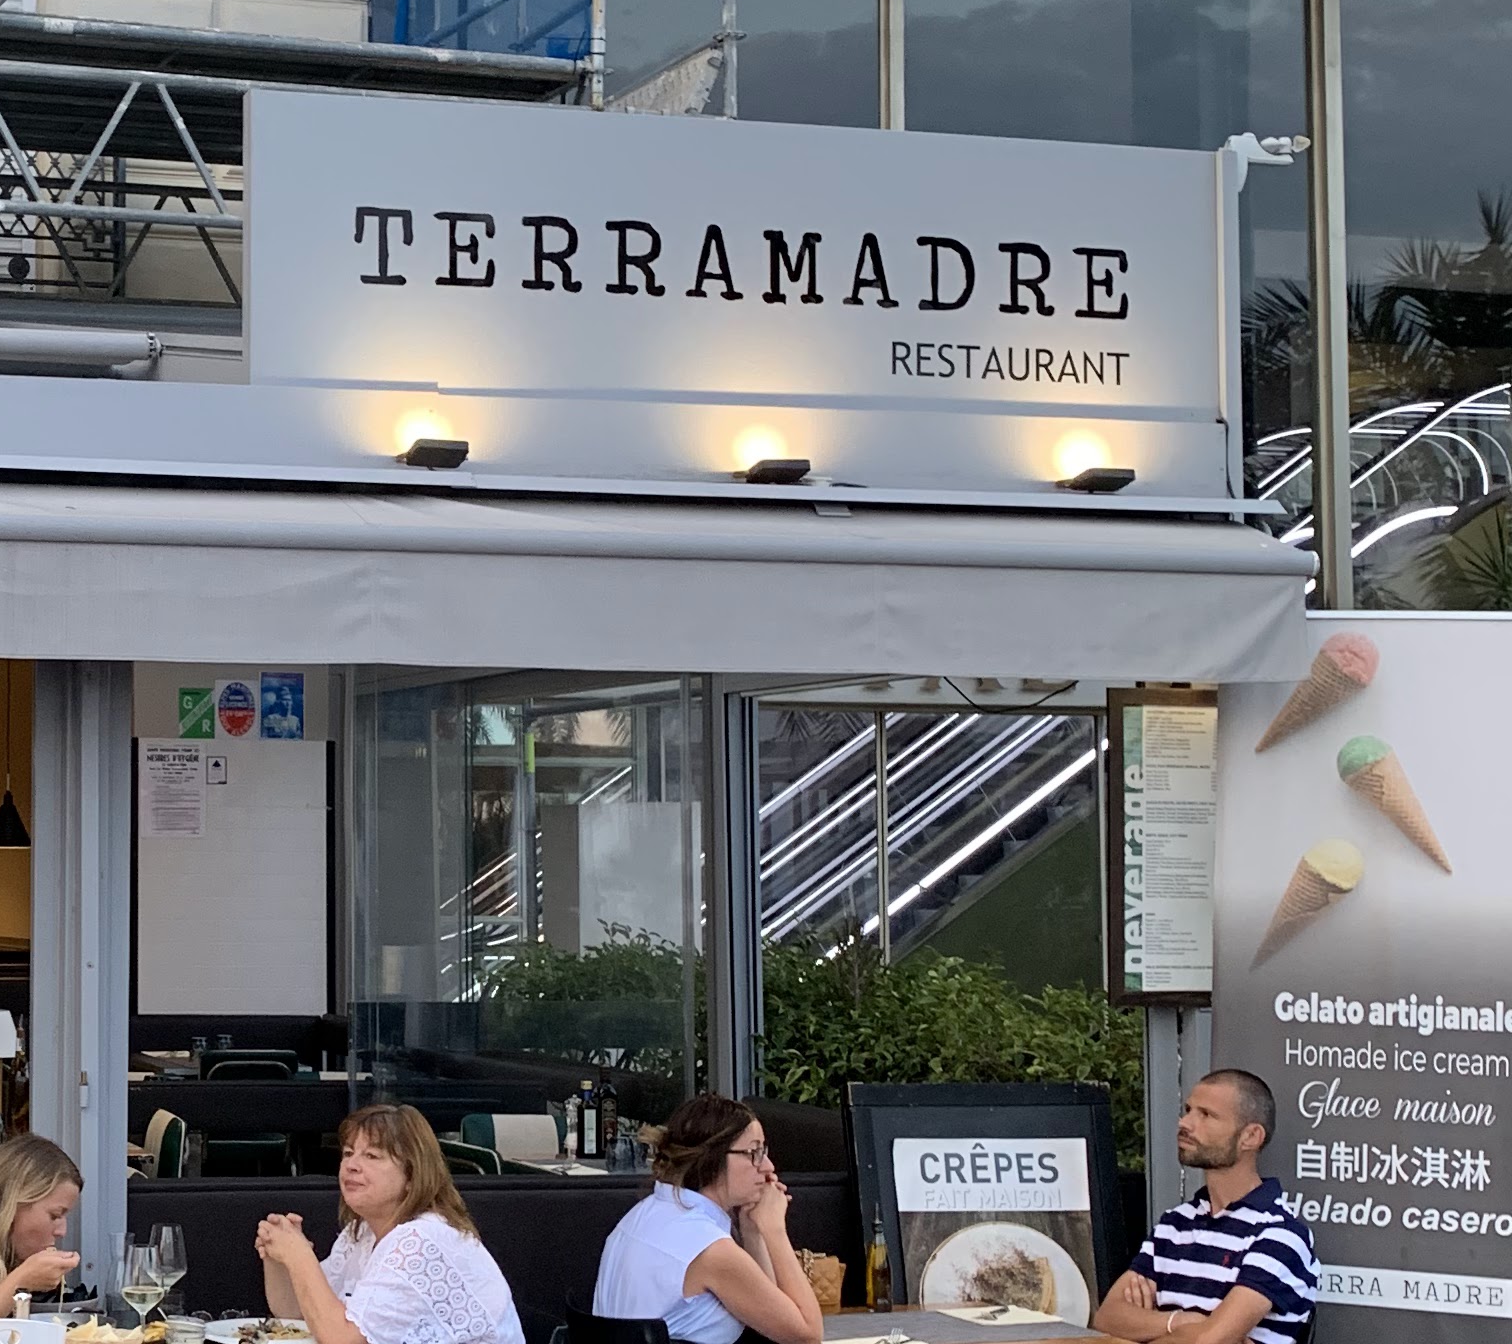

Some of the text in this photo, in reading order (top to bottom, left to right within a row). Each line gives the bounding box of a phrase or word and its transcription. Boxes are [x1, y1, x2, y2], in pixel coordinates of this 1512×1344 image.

[354, 205, 1129, 320] TERRAMADRE
[891, 341, 1130, 386] RESTAURANT
[1274, 991, 1364, 1023] Gelato
[1285, 1038, 1510, 1077] Homade ice cream
[1298, 1077, 1496, 1128] Glace maison
[919, 1142, 1059, 1184] CRÊPES
[1296, 1139, 1491, 1192] 自制冰淇淋
[924, 1188, 1062, 1209] FAIT MAISON
[1282, 1192, 1512, 1237] Helado casero
[1316, 1273, 1505, 1306] RRA MADRE
